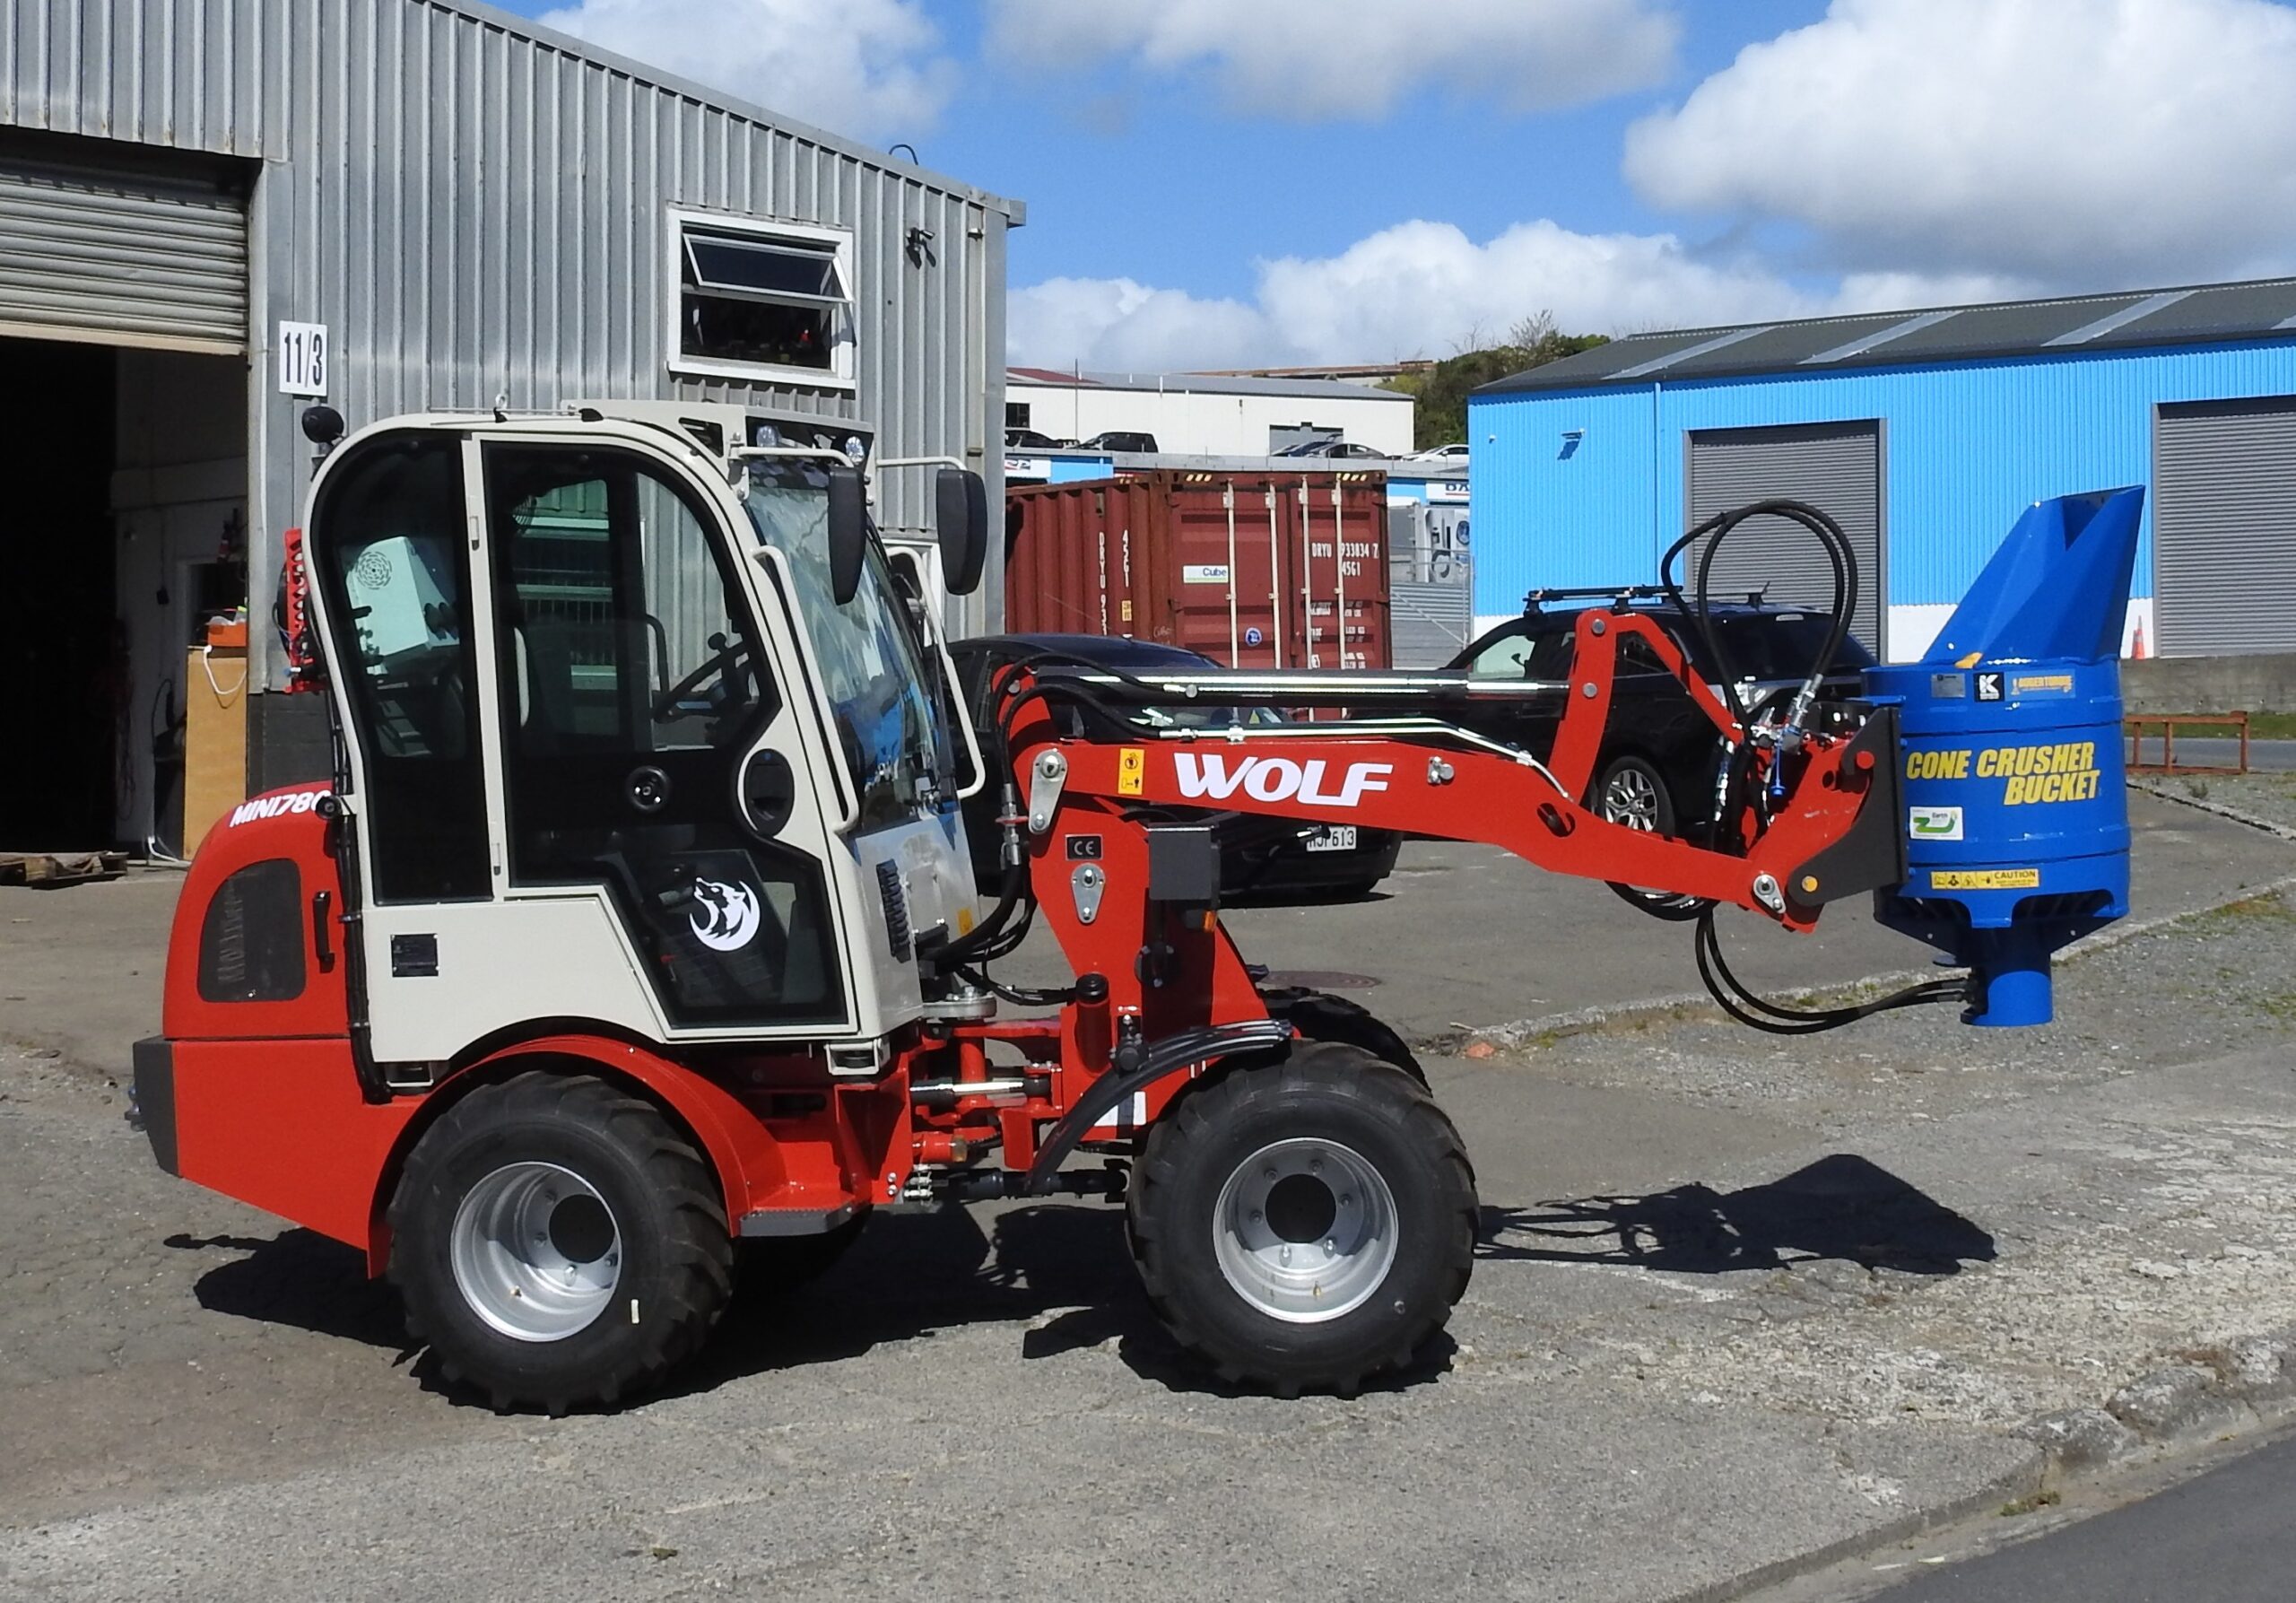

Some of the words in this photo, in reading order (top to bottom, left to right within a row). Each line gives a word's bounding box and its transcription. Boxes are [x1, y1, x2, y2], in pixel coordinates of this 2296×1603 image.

[284, 330, 322, 388] 11/3
[1203, 567, 1227, 577] Cube
[1906, 750, 1971, 780] CONE
[1976, 741, 2094, 778] CRUSHER
[1173, 752, 1394, 806] WOLF
[2003, 770, 2100, 806] BUCKET
[1074, 841, 1095, 856] CE
[1994, 870, 2036, 880] CAUTION
